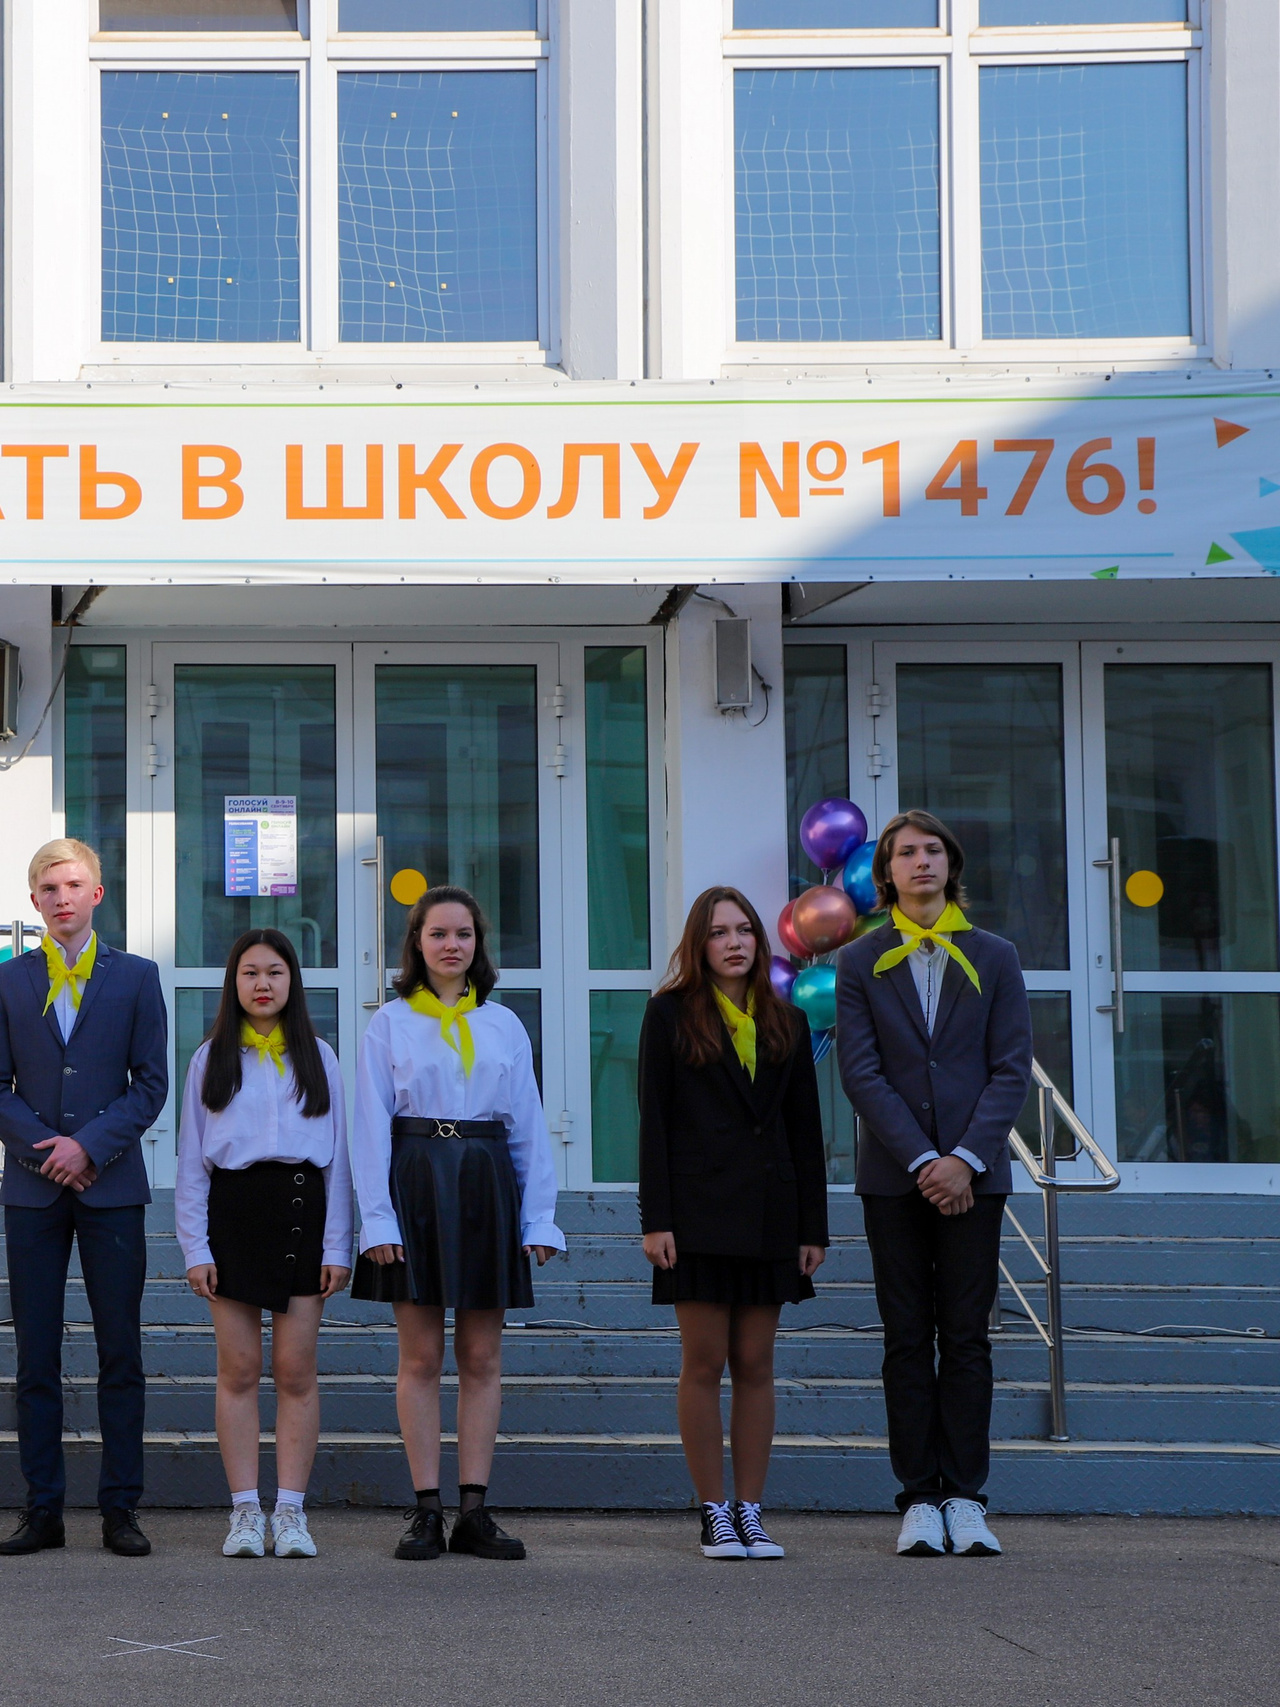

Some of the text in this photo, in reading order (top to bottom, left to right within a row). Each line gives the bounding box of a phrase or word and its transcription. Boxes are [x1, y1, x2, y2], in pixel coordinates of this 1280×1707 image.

[183, 445, 243, 519] В
[286, 443, 698, 519] ШКОЛУ
[740, 439, 1154, 517] №1476!
[228, 798, 268, 806] ГОЛОСУЙ
